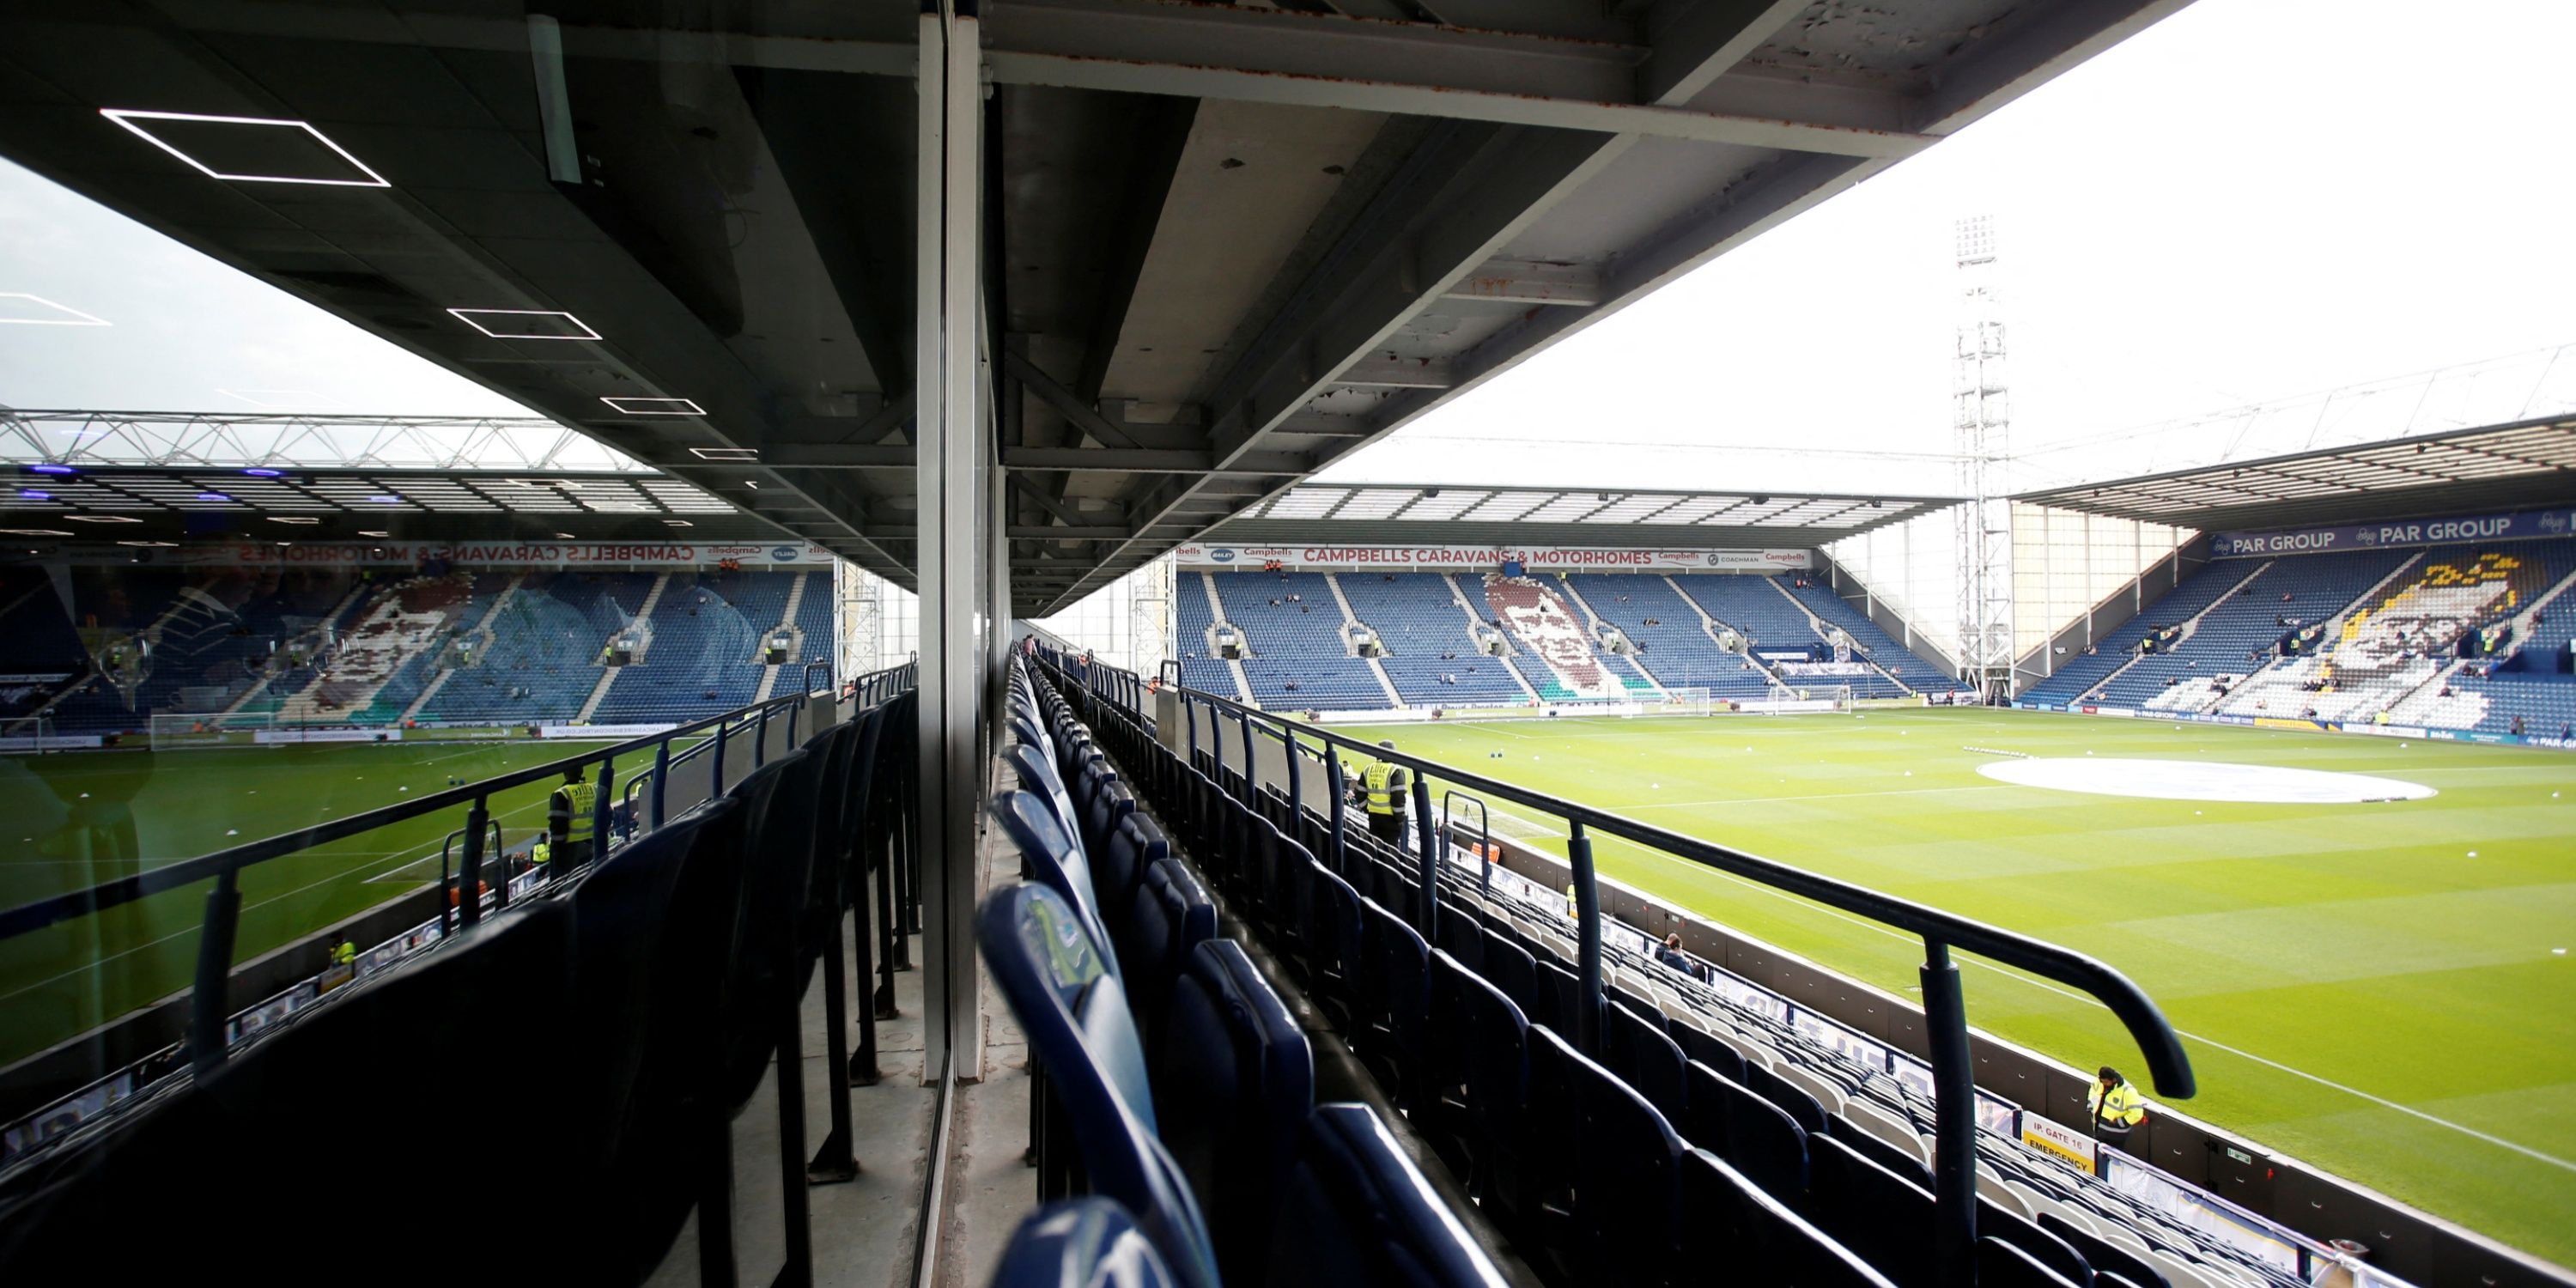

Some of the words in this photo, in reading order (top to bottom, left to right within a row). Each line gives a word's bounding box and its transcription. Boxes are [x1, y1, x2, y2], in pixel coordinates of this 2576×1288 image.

[2380, 526, 2421, 543] PAR
[2427, 519, 2512, 539] GROUP
[2233, 538, 2265, 553] PAR
[2269, 532, 2335, 550] GROUP
[1244, 547, 1292, 556] Campbells
[1303, 549, 1412, 562] CAMPBELLS
[1416, 550, 1512, 563] CARAVANS
[1517, 550, 1528, 563] &
[1534, 550, 1651, 564] MOTORHOMES
[1658, 551, 1698, 560] Campbells
[1765, 552, 1804, 562] Campbells
[2045, 1127, 2069, 1144] GATE
[2029, 1139, 2087, 1170] EMERGENCY
